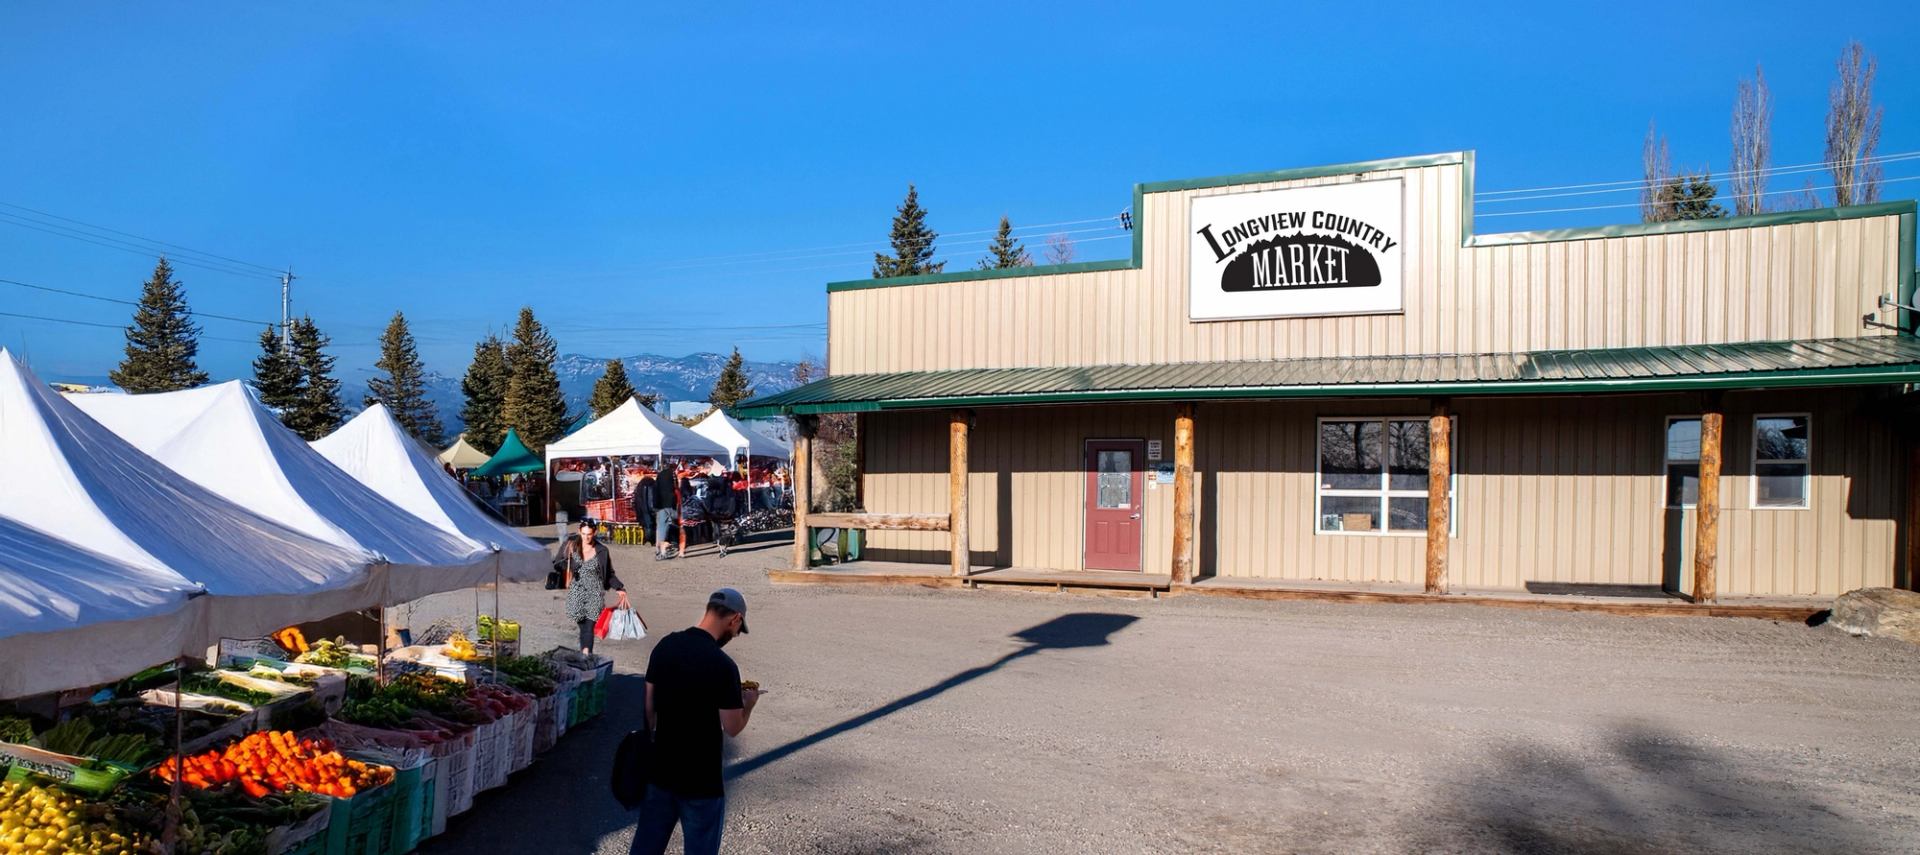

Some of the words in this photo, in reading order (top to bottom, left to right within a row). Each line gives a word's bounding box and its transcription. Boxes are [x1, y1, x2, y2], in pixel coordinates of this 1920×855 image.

[1197, 211, 1306, 263] LONGVIEW
[1312, 210, 1397, 254] COUNTRY
[1251, 243, 1350, 288] MARKET
